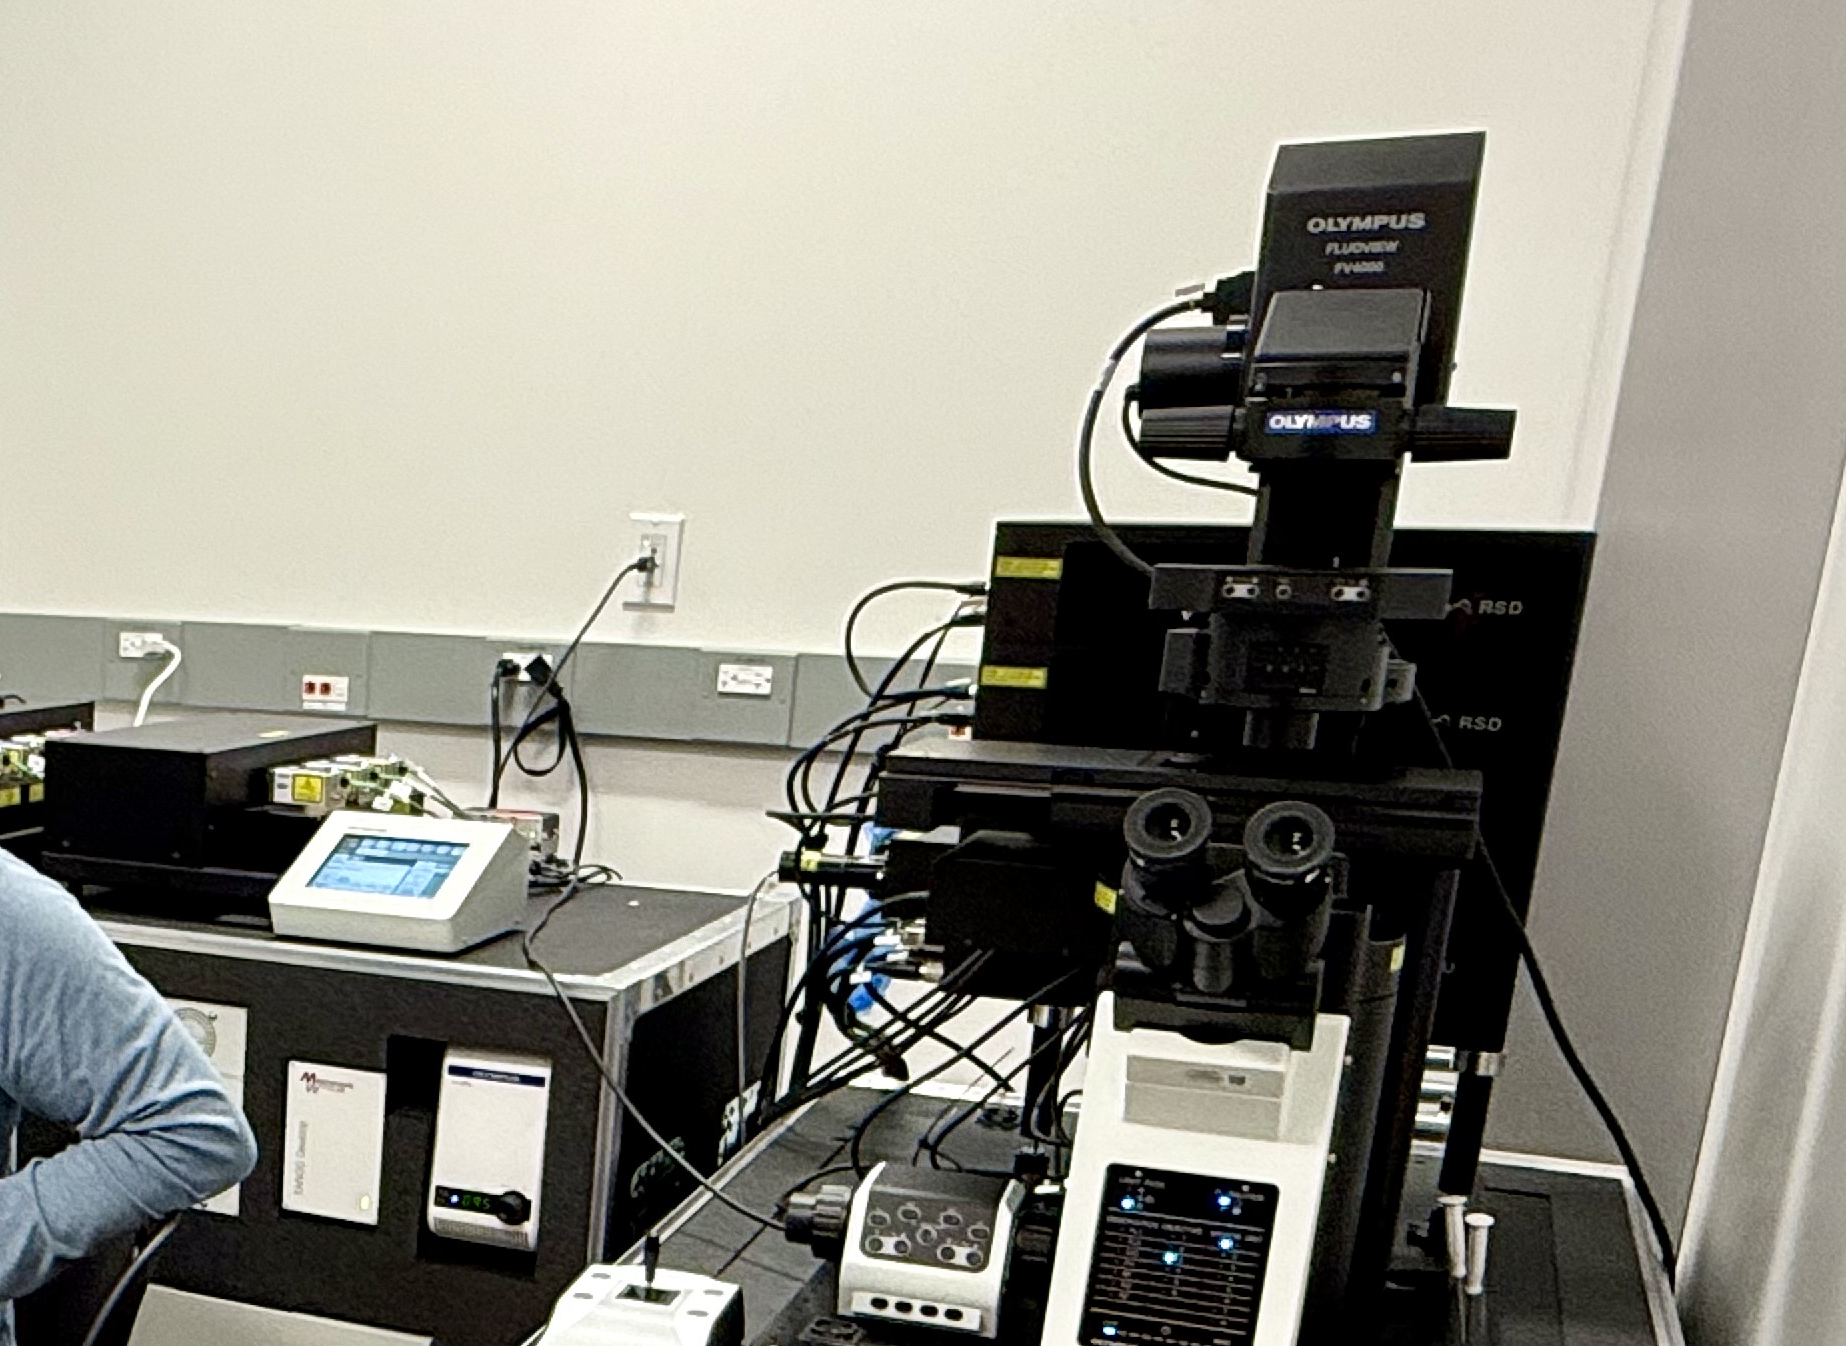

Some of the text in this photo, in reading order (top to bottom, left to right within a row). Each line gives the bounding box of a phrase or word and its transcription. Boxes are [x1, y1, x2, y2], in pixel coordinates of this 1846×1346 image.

[1306, 212, 1426, 234] OLYMPUS
[1268, 414, 1372, 430] OLYMPUS
[1478, 600, 1523, 615] RSD
[1458, 716, 1502, 731] RSD
